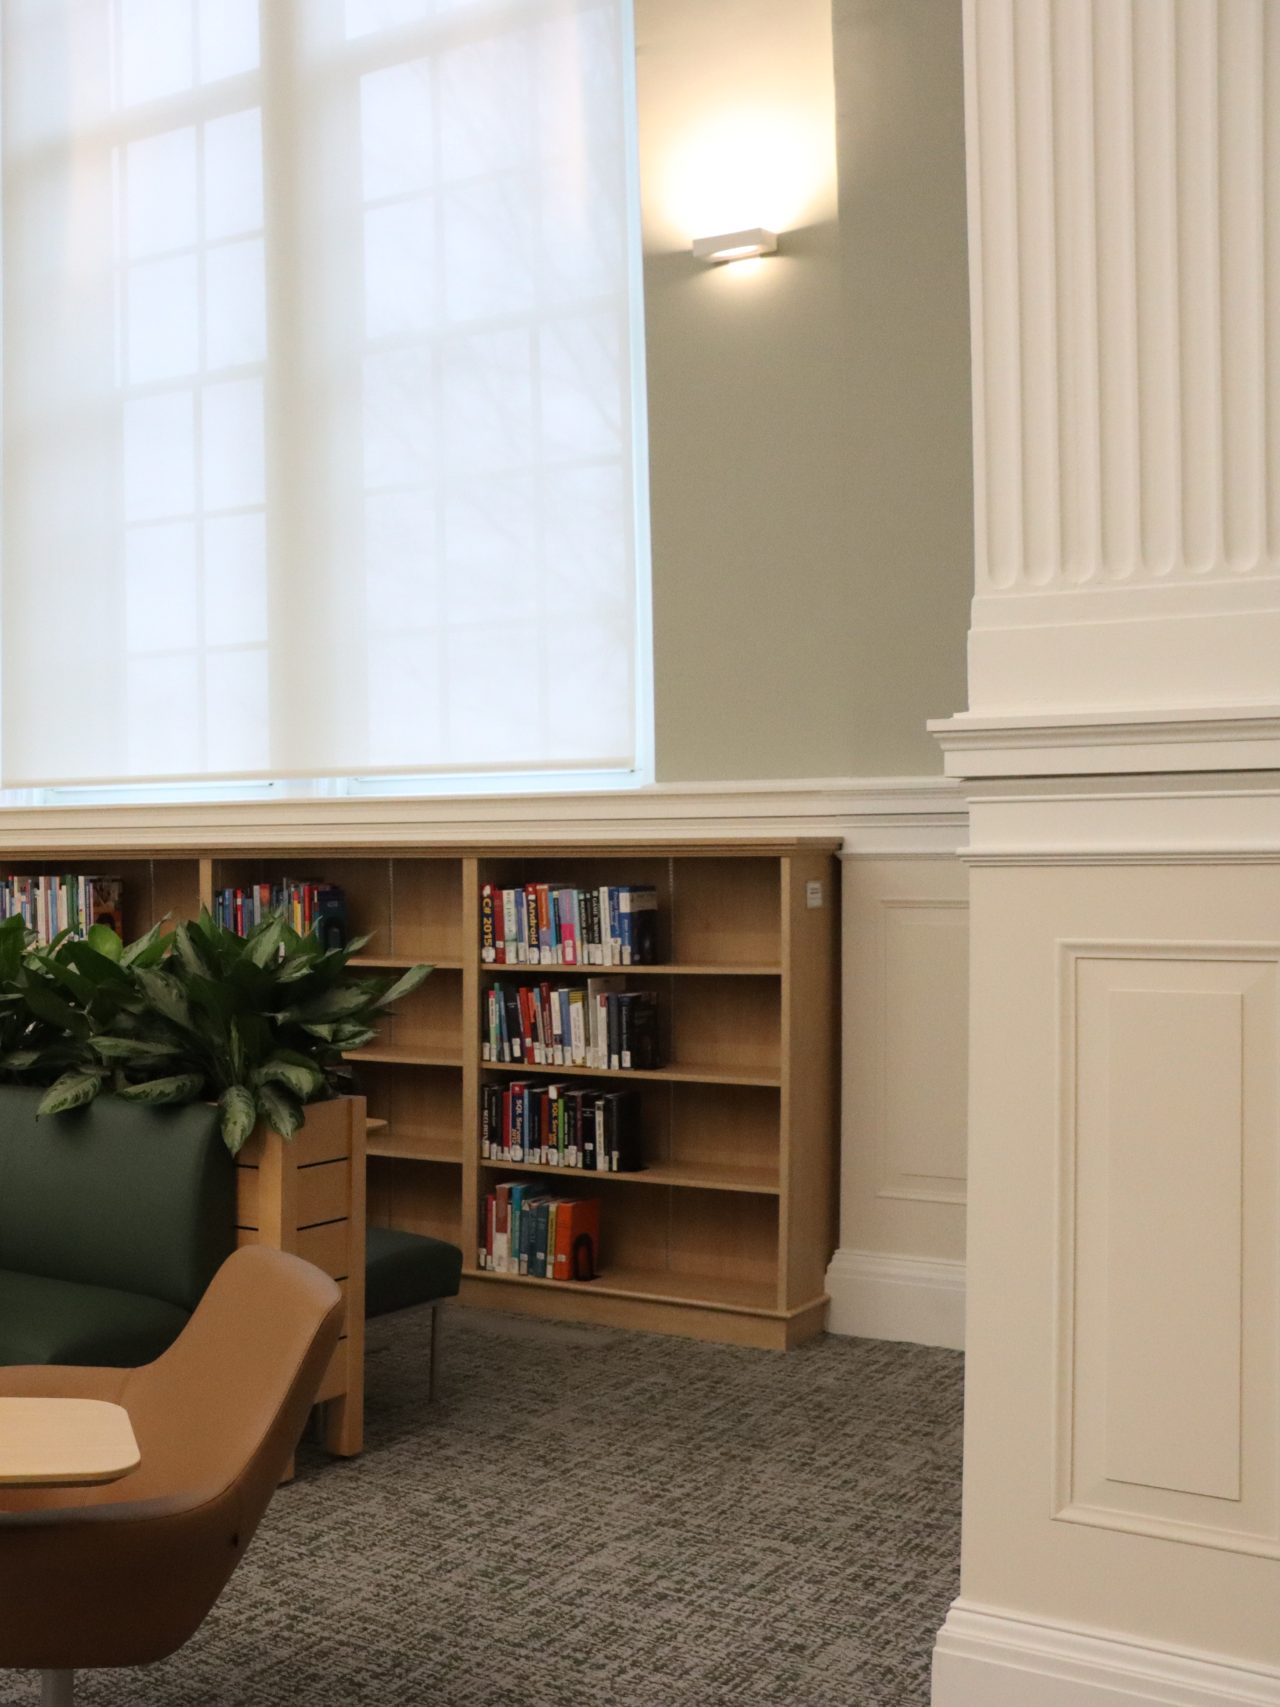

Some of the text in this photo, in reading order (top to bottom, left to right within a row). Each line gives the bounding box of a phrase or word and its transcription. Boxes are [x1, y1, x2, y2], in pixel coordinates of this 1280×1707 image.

[483, 898, 492, 946] C# 2015
[529, 901, 538, 945] Android
